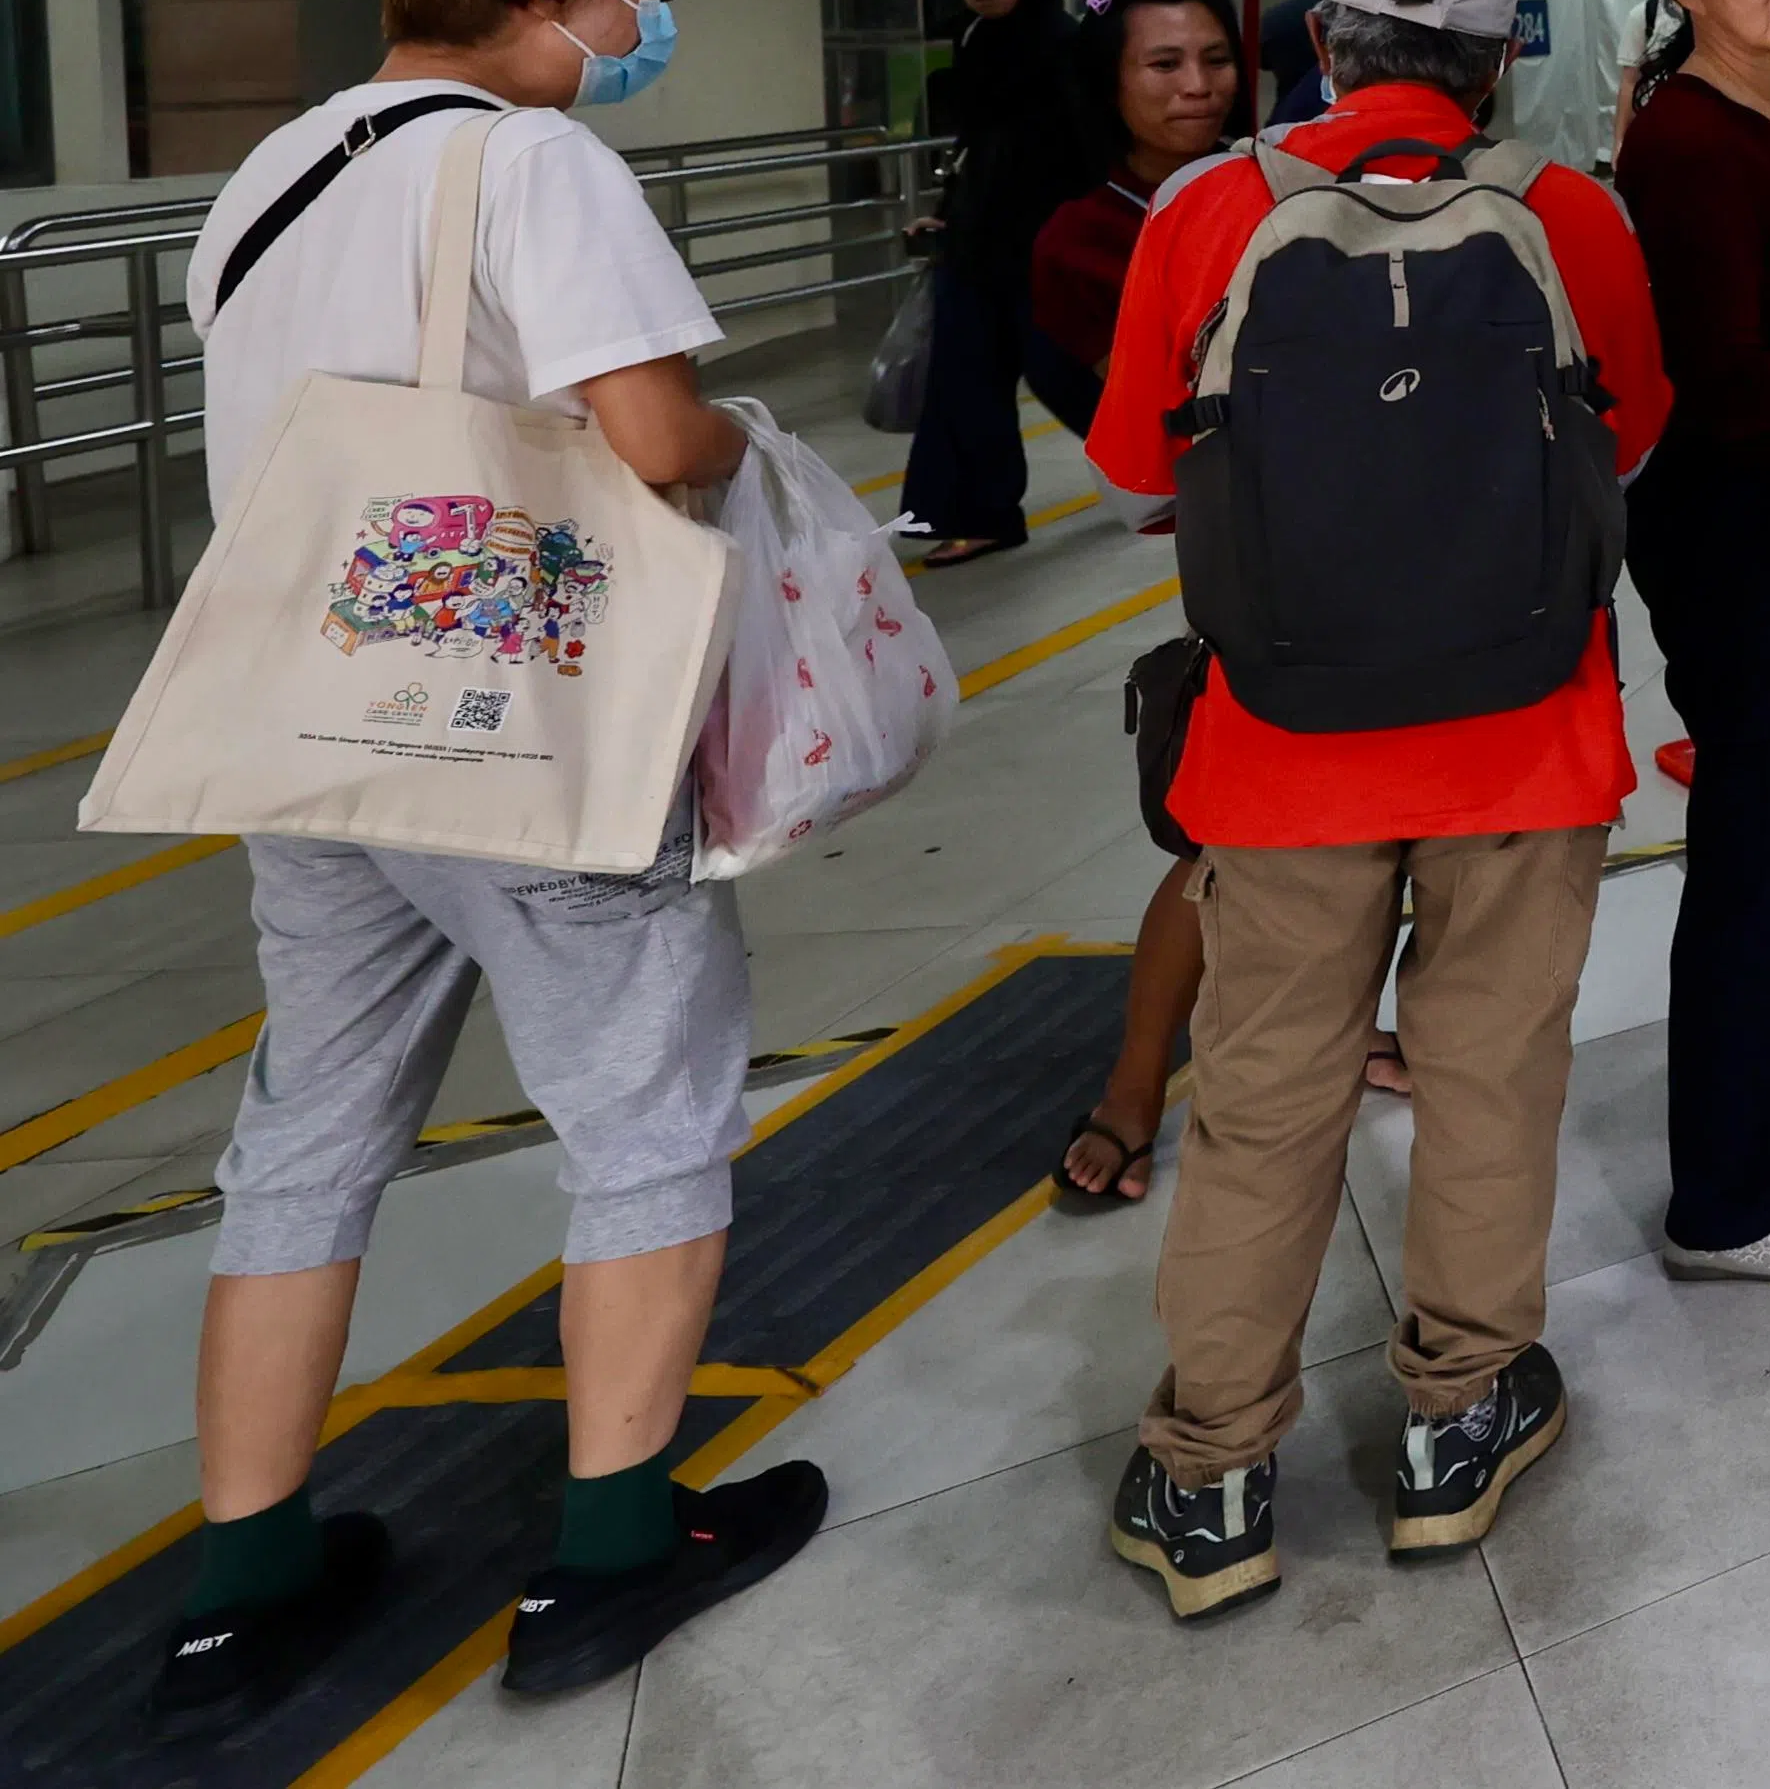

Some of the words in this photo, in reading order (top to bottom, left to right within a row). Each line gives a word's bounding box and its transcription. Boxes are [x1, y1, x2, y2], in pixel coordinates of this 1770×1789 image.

[558, 877, 576, 890] BY
[519, 1597, 556, 1613] MBT
[176, 1632, 234, 1658] MBT
